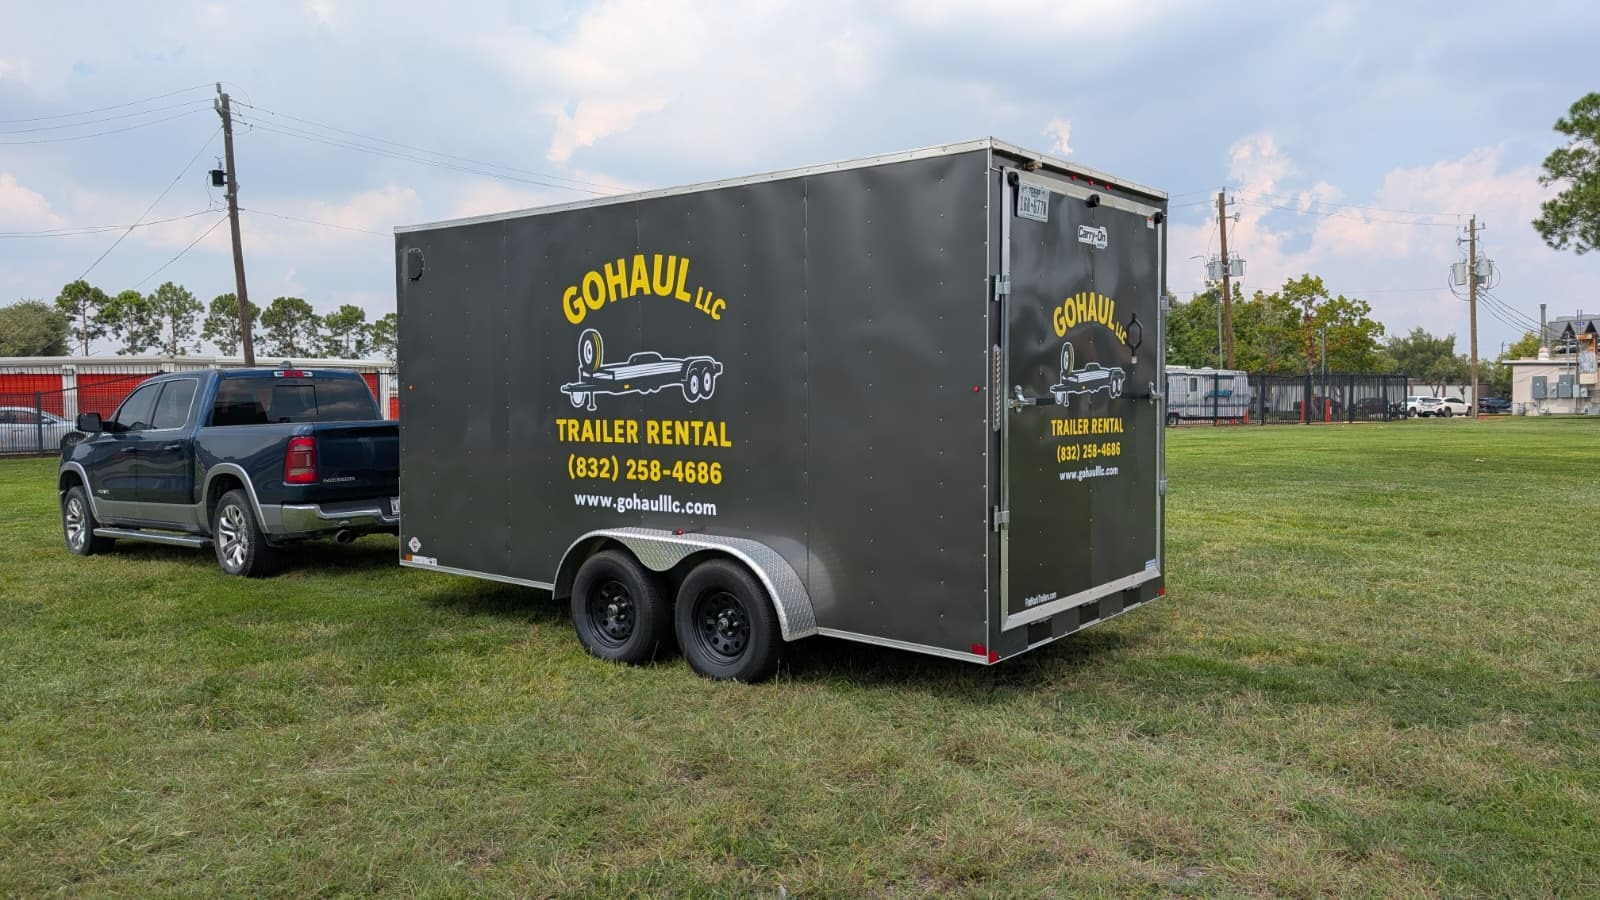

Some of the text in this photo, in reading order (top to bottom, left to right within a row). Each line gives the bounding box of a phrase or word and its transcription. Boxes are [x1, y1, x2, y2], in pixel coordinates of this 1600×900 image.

[1078, 226, 1106, 243] Carry-On
[562, 254, 726, 325] GOHAUL LLC
[1053, 291, 1127, 345] GOHAUL LLC
[556, 418, 732, 448] TRAILER RENTAL
[1051, 417, 1124, 437] TRAILER RENTAL
[1057, 441, 1121, 463] (832) 258-4686
[568, 453, 723, 485] (832) 258-4686
[1059, 465, 1119, 481] www.gohaulllc.com
[574, 493, 717, 516] www.gohaulllc.com
